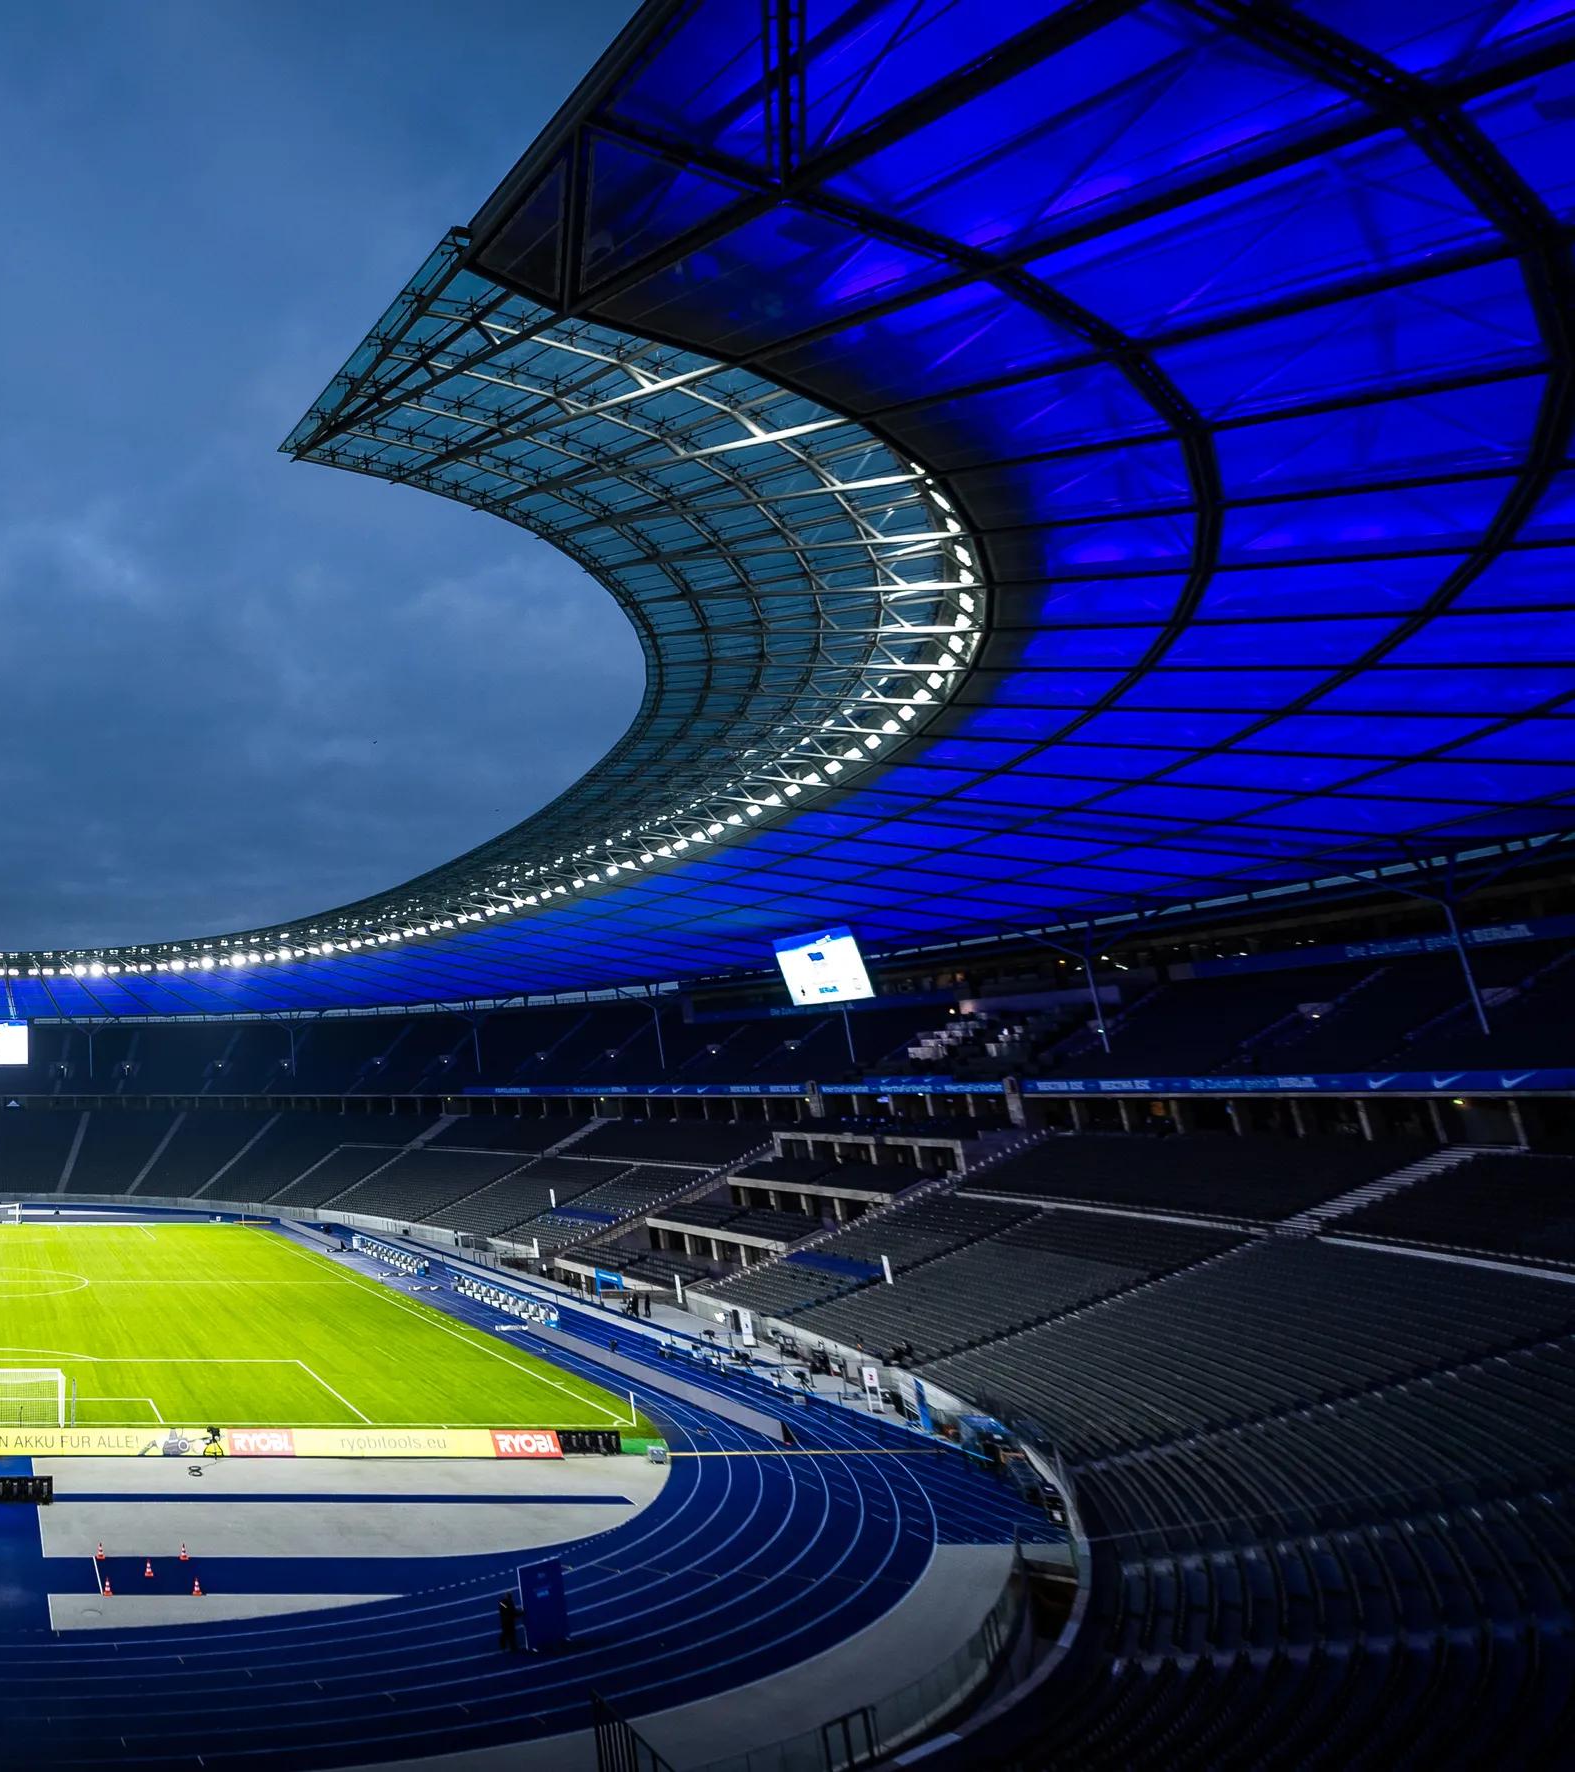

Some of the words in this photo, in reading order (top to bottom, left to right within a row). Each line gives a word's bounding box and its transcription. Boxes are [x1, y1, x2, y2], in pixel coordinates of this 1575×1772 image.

[14, 1435, 55, 1449] AKKU
[97, 1434, 140, 1449] ALLE!
[340, 1435, 447, 1451] ryobitools.eu
